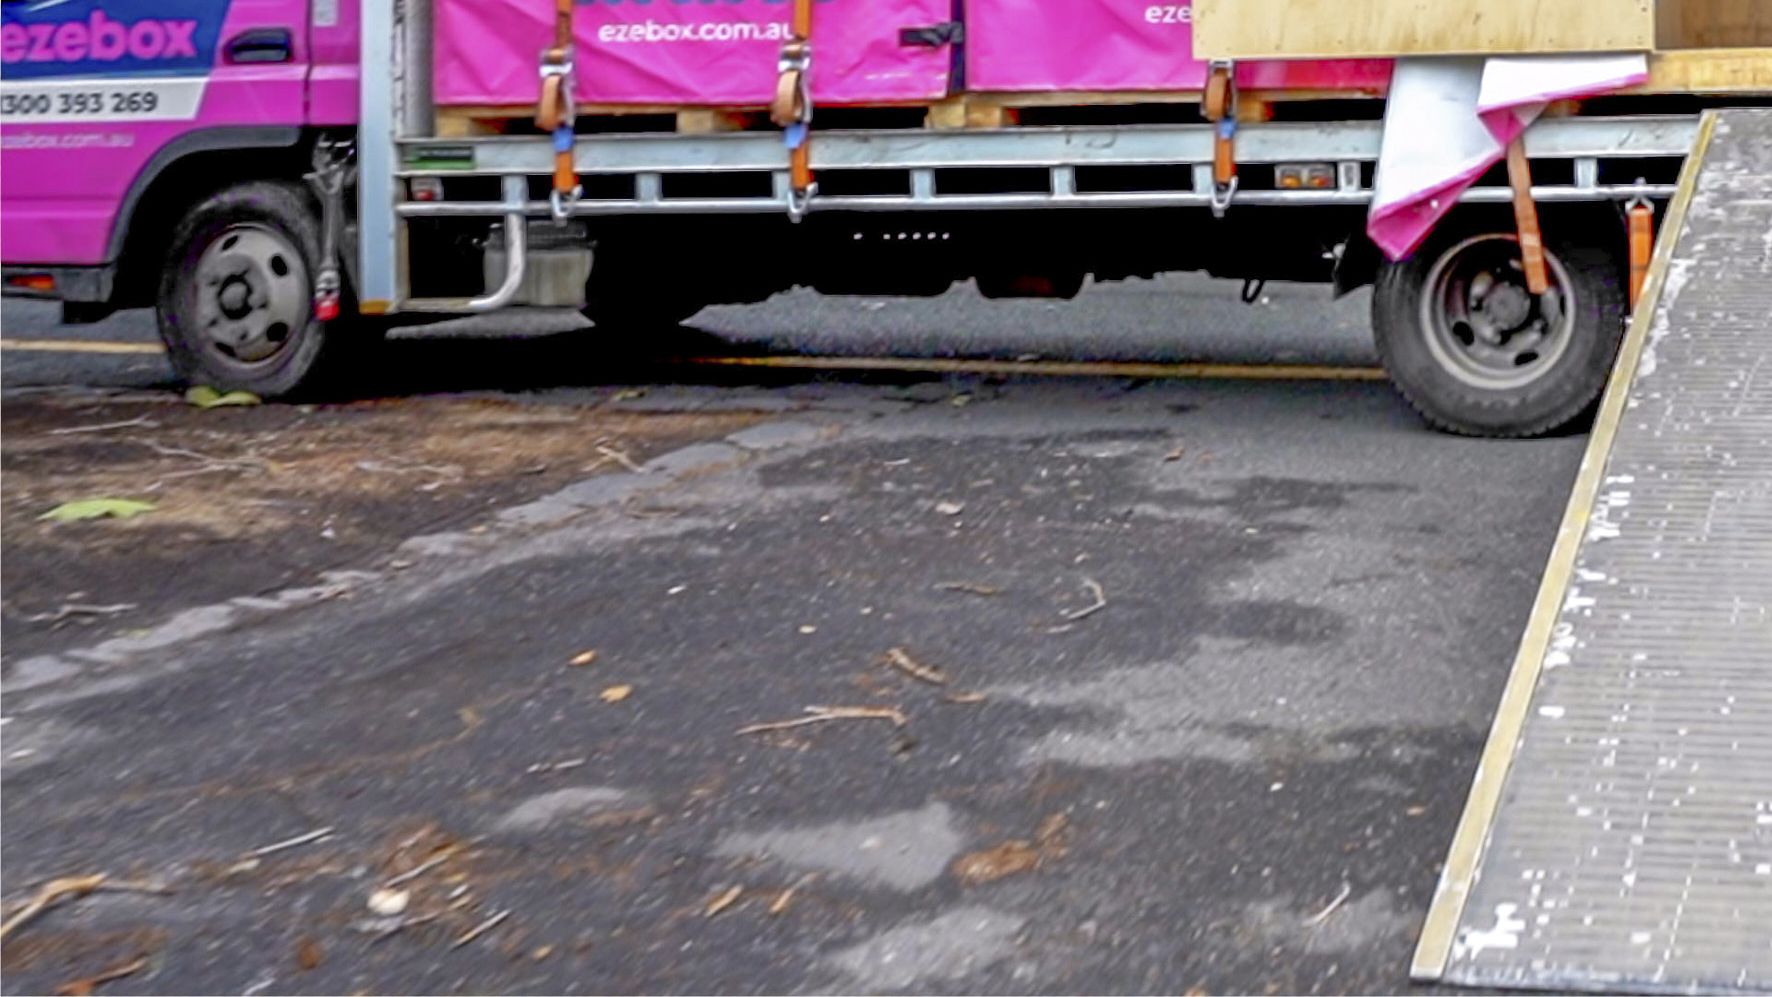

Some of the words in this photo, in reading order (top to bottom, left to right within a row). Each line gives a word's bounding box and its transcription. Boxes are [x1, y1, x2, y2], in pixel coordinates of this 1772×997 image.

[1, 9, 198, 63] ezebox
[58, 93, 104, 114] 393
[110, 91, 159, 113] 269
